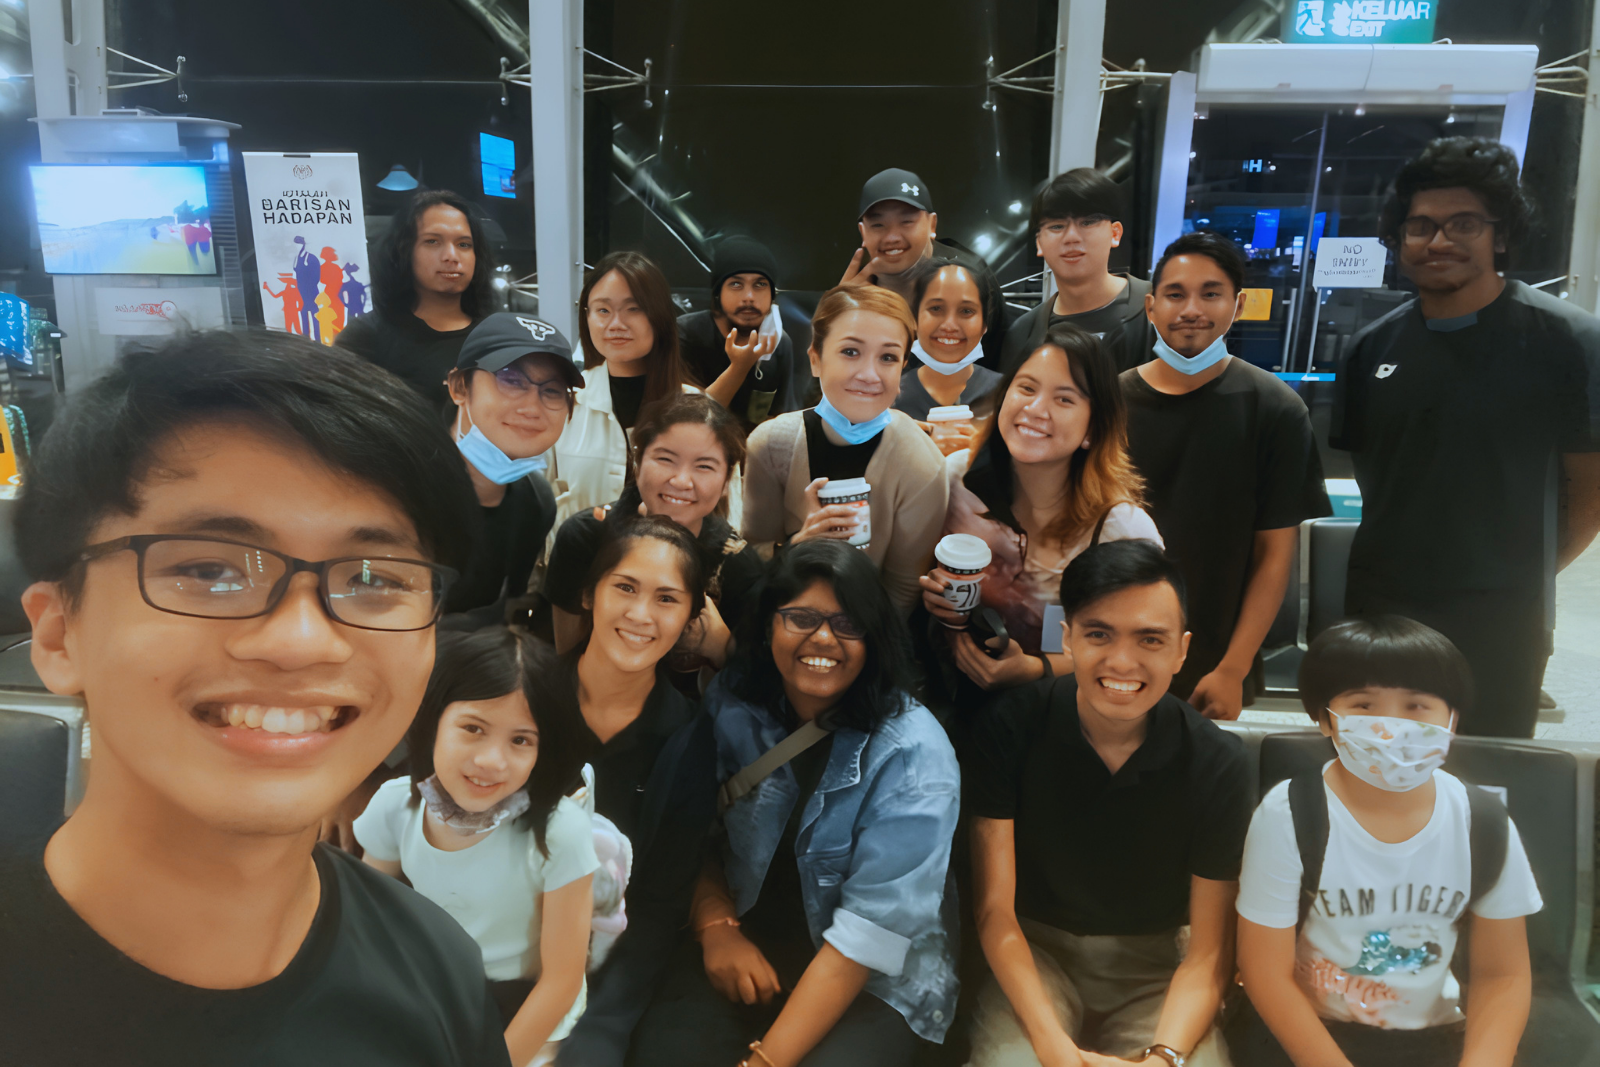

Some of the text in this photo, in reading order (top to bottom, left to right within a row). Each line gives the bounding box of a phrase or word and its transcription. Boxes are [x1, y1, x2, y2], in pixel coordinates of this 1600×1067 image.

[1351, 0, 1430, 20] KELUAR
[261, 198, 351, 211] BARISAN
[263, 211, 353, 225] HADAPAN
[1343, 244, 1363, 255] NO
